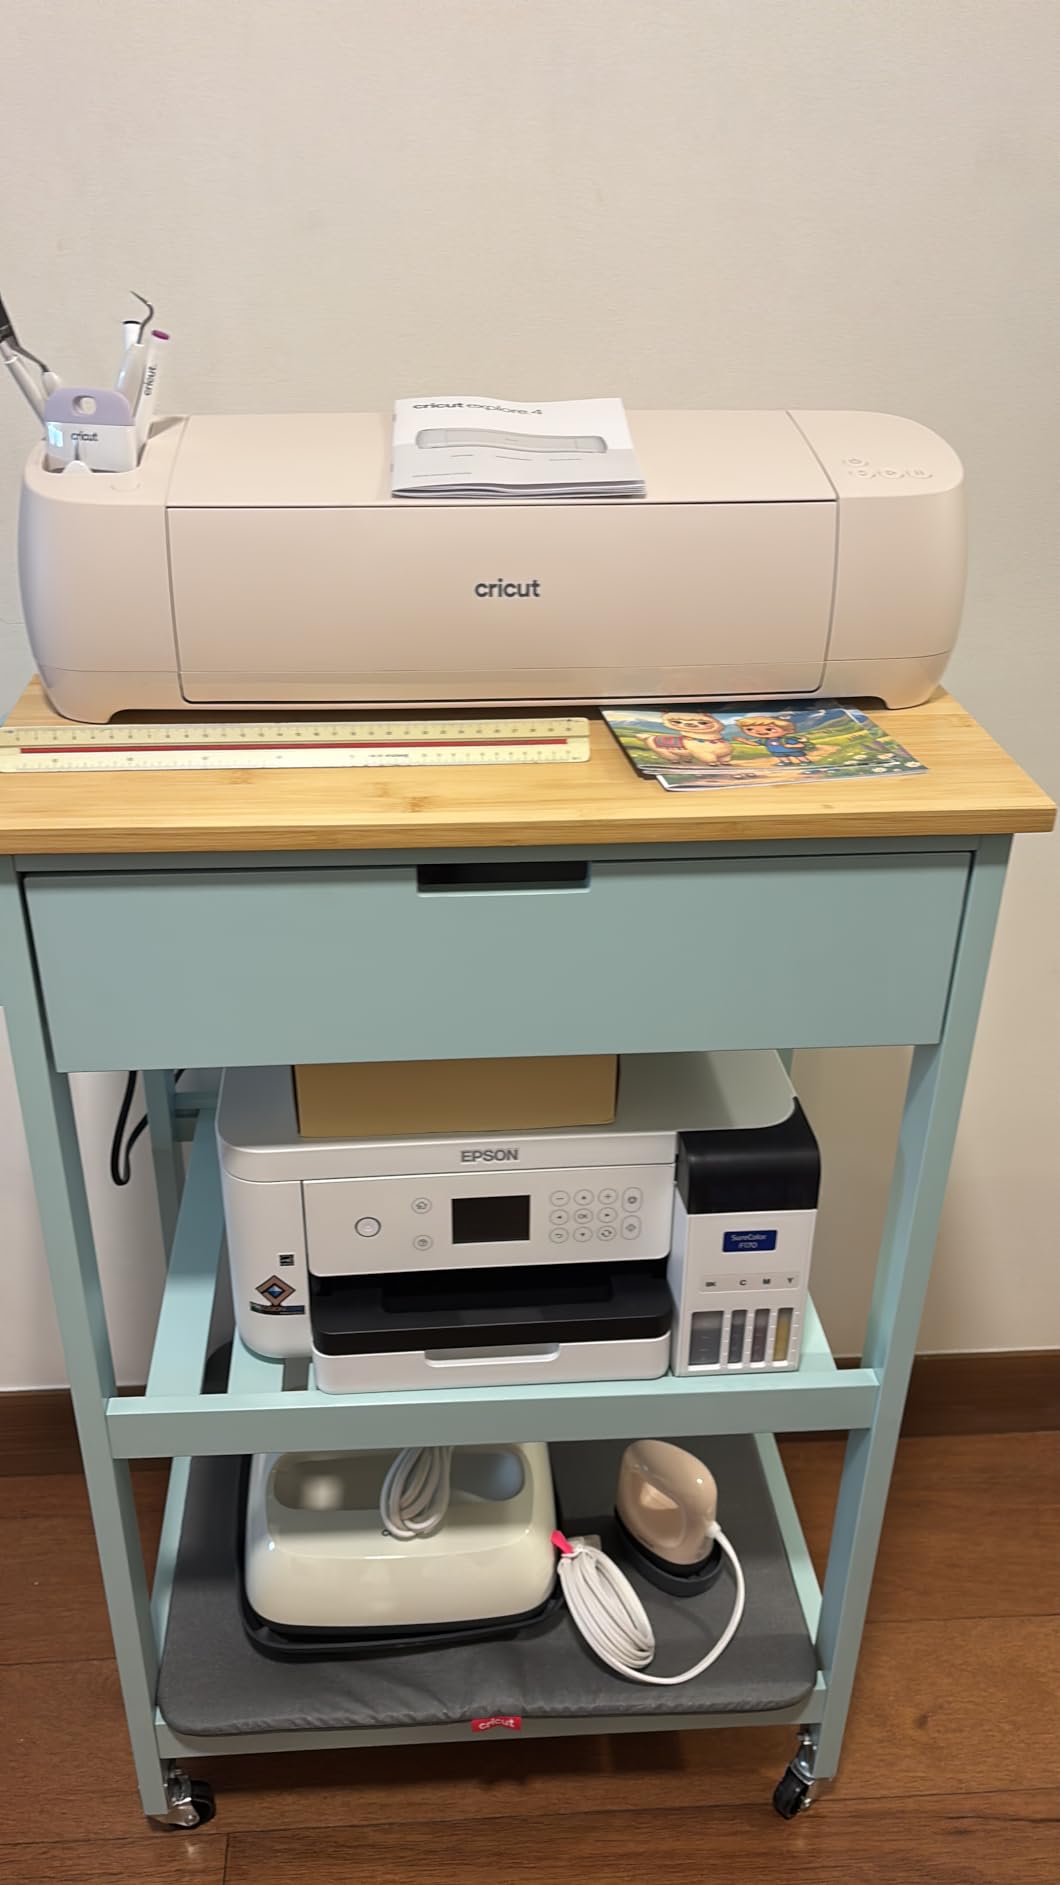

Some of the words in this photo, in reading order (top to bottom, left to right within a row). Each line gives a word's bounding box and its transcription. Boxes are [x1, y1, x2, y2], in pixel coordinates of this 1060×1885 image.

[466, 403, 528, 415] explore
[71, 431, 98, 441] cricut
[475, 578, 541, 597] cricut
[460, 1148, 519, 1162] EPSON
[478, 1718, 514, 1729] cricut
